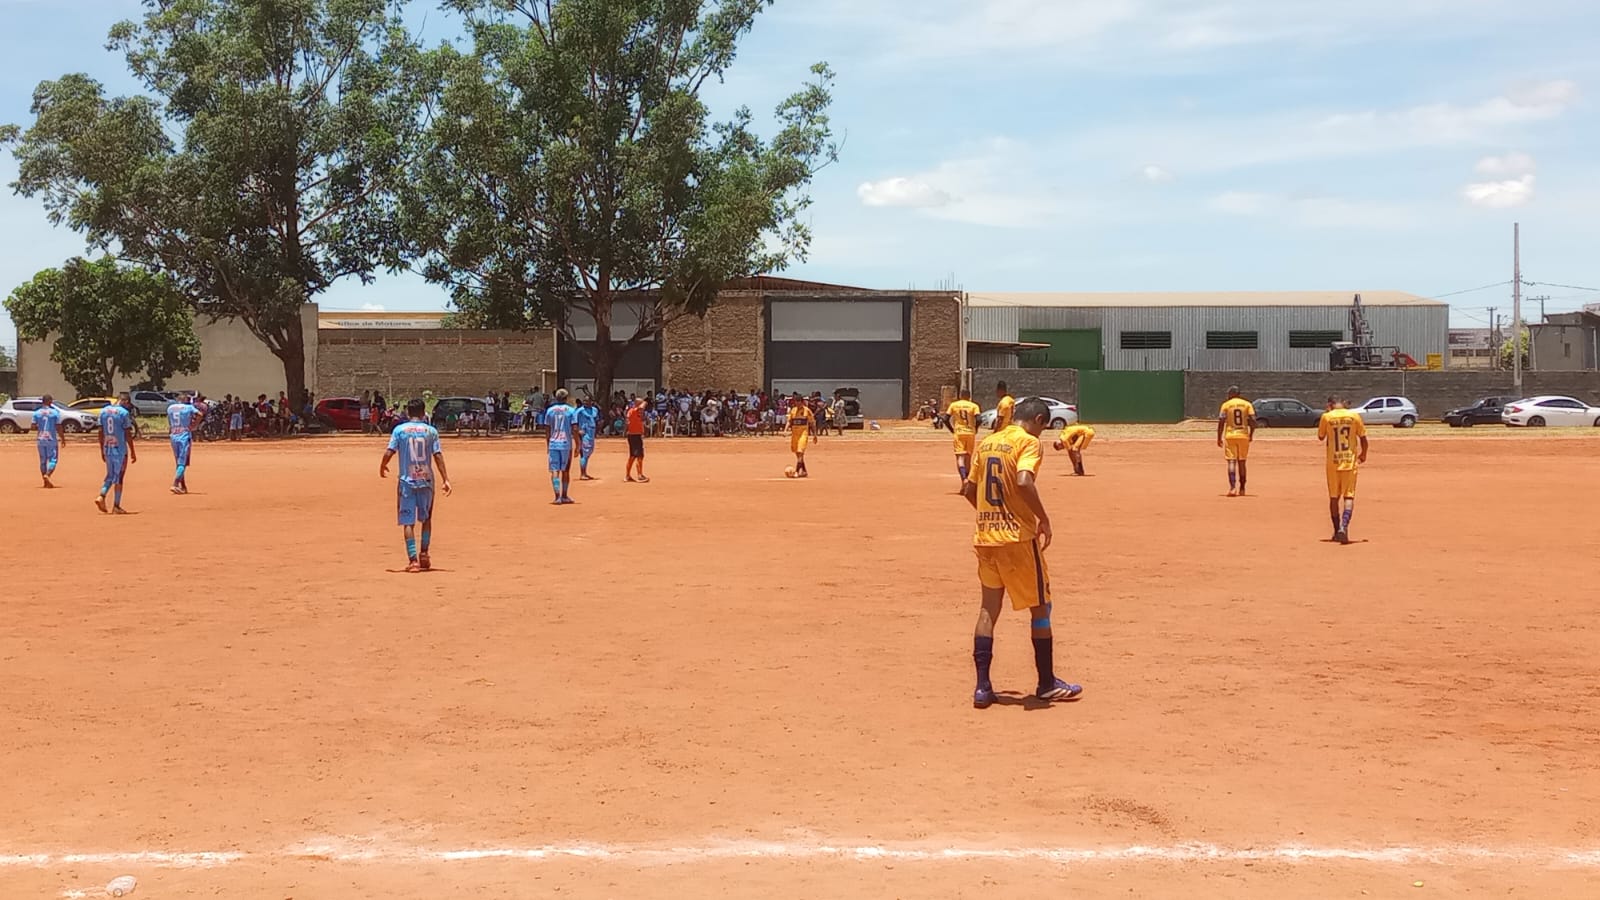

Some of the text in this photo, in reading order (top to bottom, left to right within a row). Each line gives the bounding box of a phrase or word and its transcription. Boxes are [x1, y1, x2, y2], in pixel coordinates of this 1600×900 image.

[42, 416, 49, 432] 7
[107, 416, 114, 434] 8
[172, 412, 180, 426] 5
[554, 414, 565, 431] 17
[1233, 408, 1243, 426] 8
[1333, 426, 1351, 452] 13
[408, 436, 427, 462] 10
[985, 456, 1003, 507] 6
